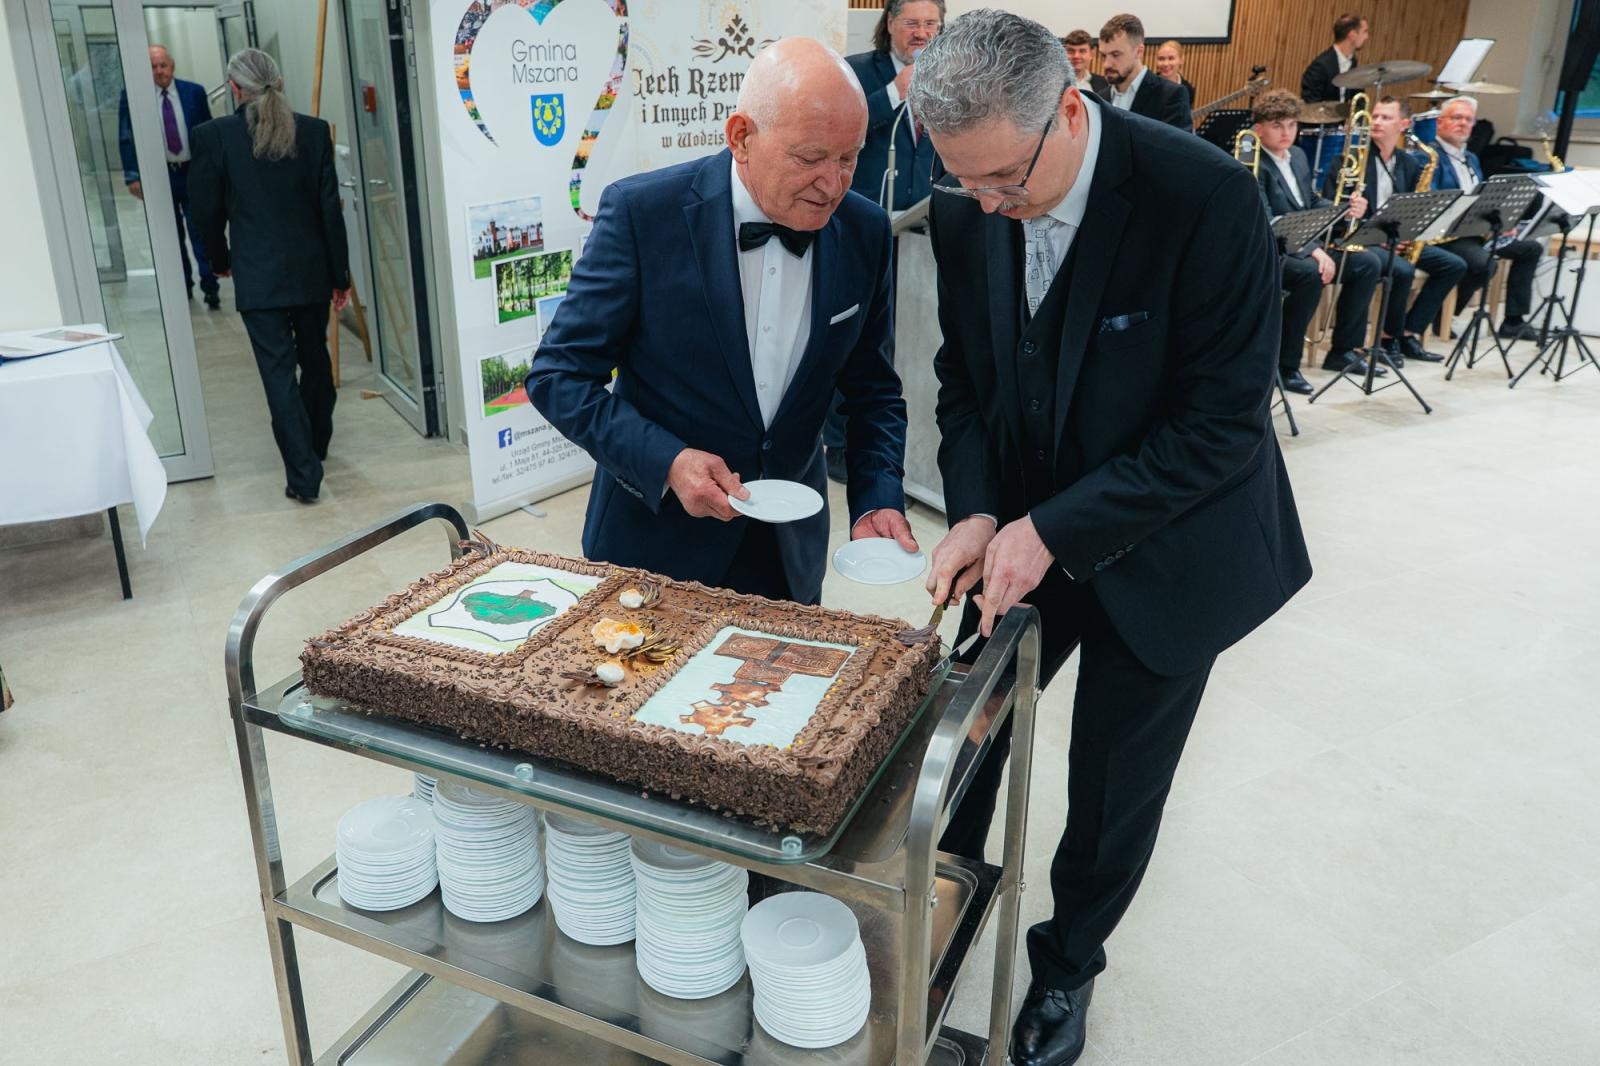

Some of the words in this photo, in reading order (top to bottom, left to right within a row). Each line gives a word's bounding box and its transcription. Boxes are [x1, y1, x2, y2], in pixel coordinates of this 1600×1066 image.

[511, 39, 577, 63] Gmina
[512, 63, 578, 84] Mszana
[641, 103, 647, 123] i
[651, 101, 707, 127] Innych
[662, 136, 673, 148] w
